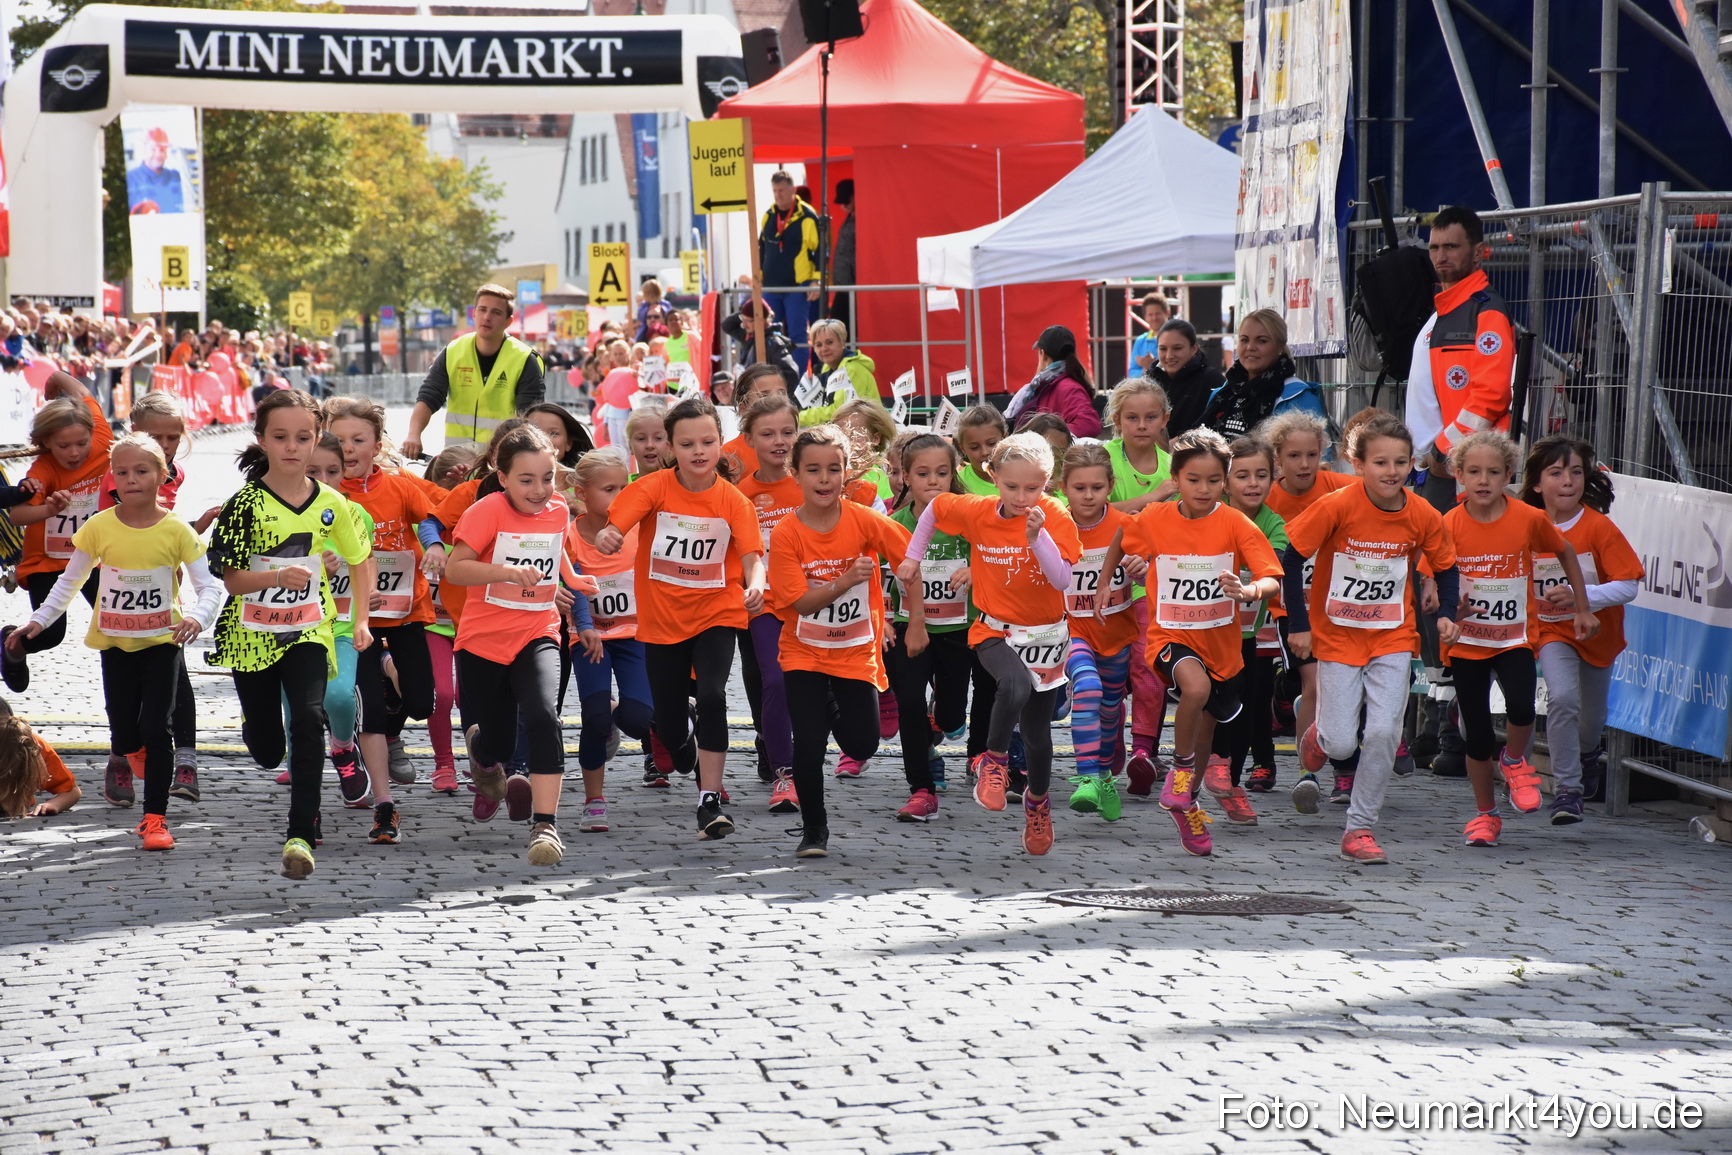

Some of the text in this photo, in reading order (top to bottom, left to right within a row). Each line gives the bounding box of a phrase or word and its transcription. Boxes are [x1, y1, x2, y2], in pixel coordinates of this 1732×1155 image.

[175, 29, 633, 78] MINI NEUMARKT.
[693, 146, 744, 162] Jugend
[710, 162, 736, 177] lauf
[592, 246, 626, 257] Block
[167, 257, 182, 278] B
[599, 262, 622, 292] A
[294, 302, 305, 318] C
[320, 319, 330, 331] D
[576, 319, 585, 331] D
[950, 378, 967, 387] swn
[809, 390, 824, 405] swn
[939, 411, 951, 430] swn
[665, 535, 717, 561] 7107
[1348, 538, 1399, 549] Neumarkter
[1345, 547, 1387, 559] Stadtlauf
[678, 566, 700, 576] Tessa
[522, 589, 535, 597] Eva
[1169, 578, 1223, 601] 7262
[1343, 576, 1395, 600] 7253
[110, 588, 162, 610] 7245
[590, 592, 629, 615] 100
[253, 610, 303, 622] EMMA
[1172, 606, 1218, 620] Fiona
[101, 615, 168, 629] MADLEN
[1014, 643, 1064, 664] 7073
